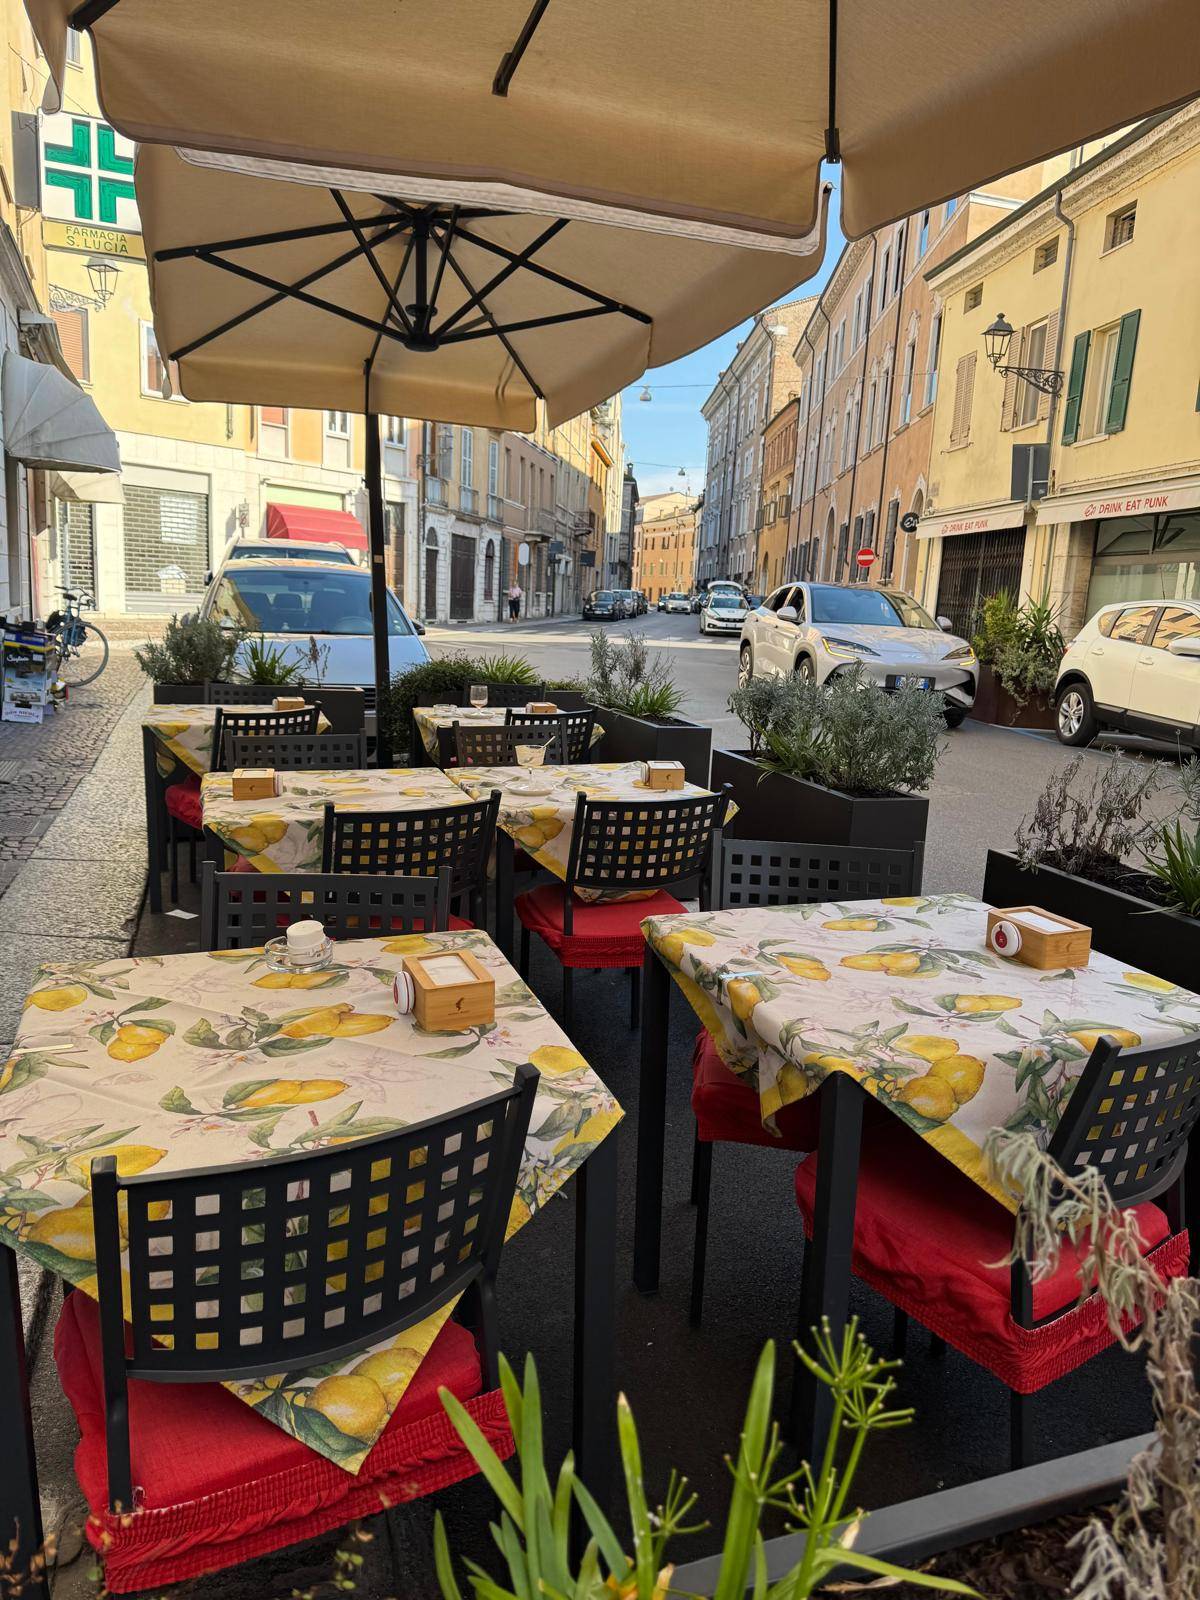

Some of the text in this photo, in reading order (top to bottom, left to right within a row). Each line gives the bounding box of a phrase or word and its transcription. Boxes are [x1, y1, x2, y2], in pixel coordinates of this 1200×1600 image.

[66, 226, 128, 243] FARMACIA
[84, 239, 129, 254] LUCIA
[1099, 502, 1123, 514] DRINK
[1125, 500, 1142, 511] EAT
[1144, 496, 1169, 508] PUNK
[949, 522, 963, 532] DRINK
[964, 521, 974, 531] EAT
[974, 519, 988, 529] PUNK
